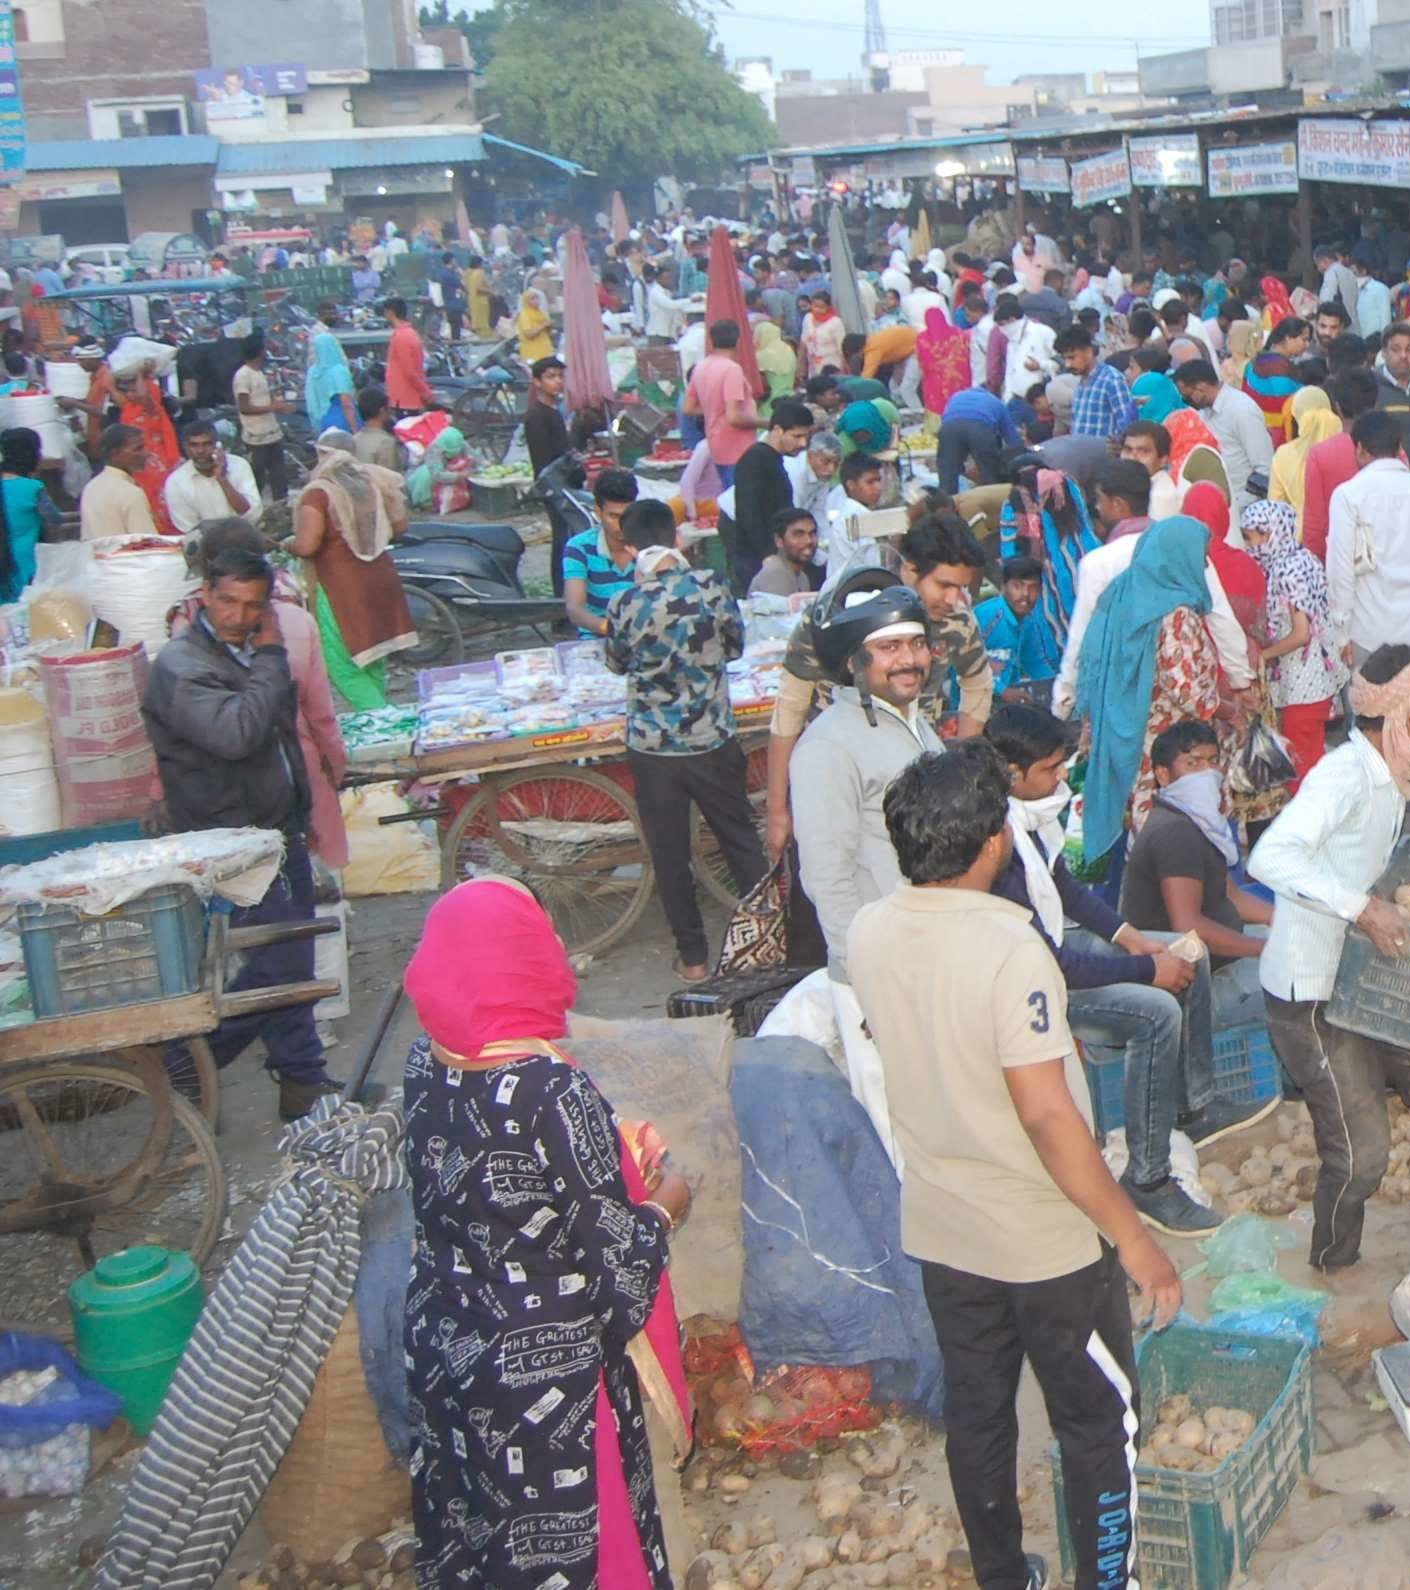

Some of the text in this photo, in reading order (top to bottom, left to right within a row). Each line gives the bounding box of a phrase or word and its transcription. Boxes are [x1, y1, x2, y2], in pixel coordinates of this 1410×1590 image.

[1027, 991, 1050, 1034] 3
[503, 1326, 588, 1352] THE GREATEST
[512, 1520, 537, 1536] THE
